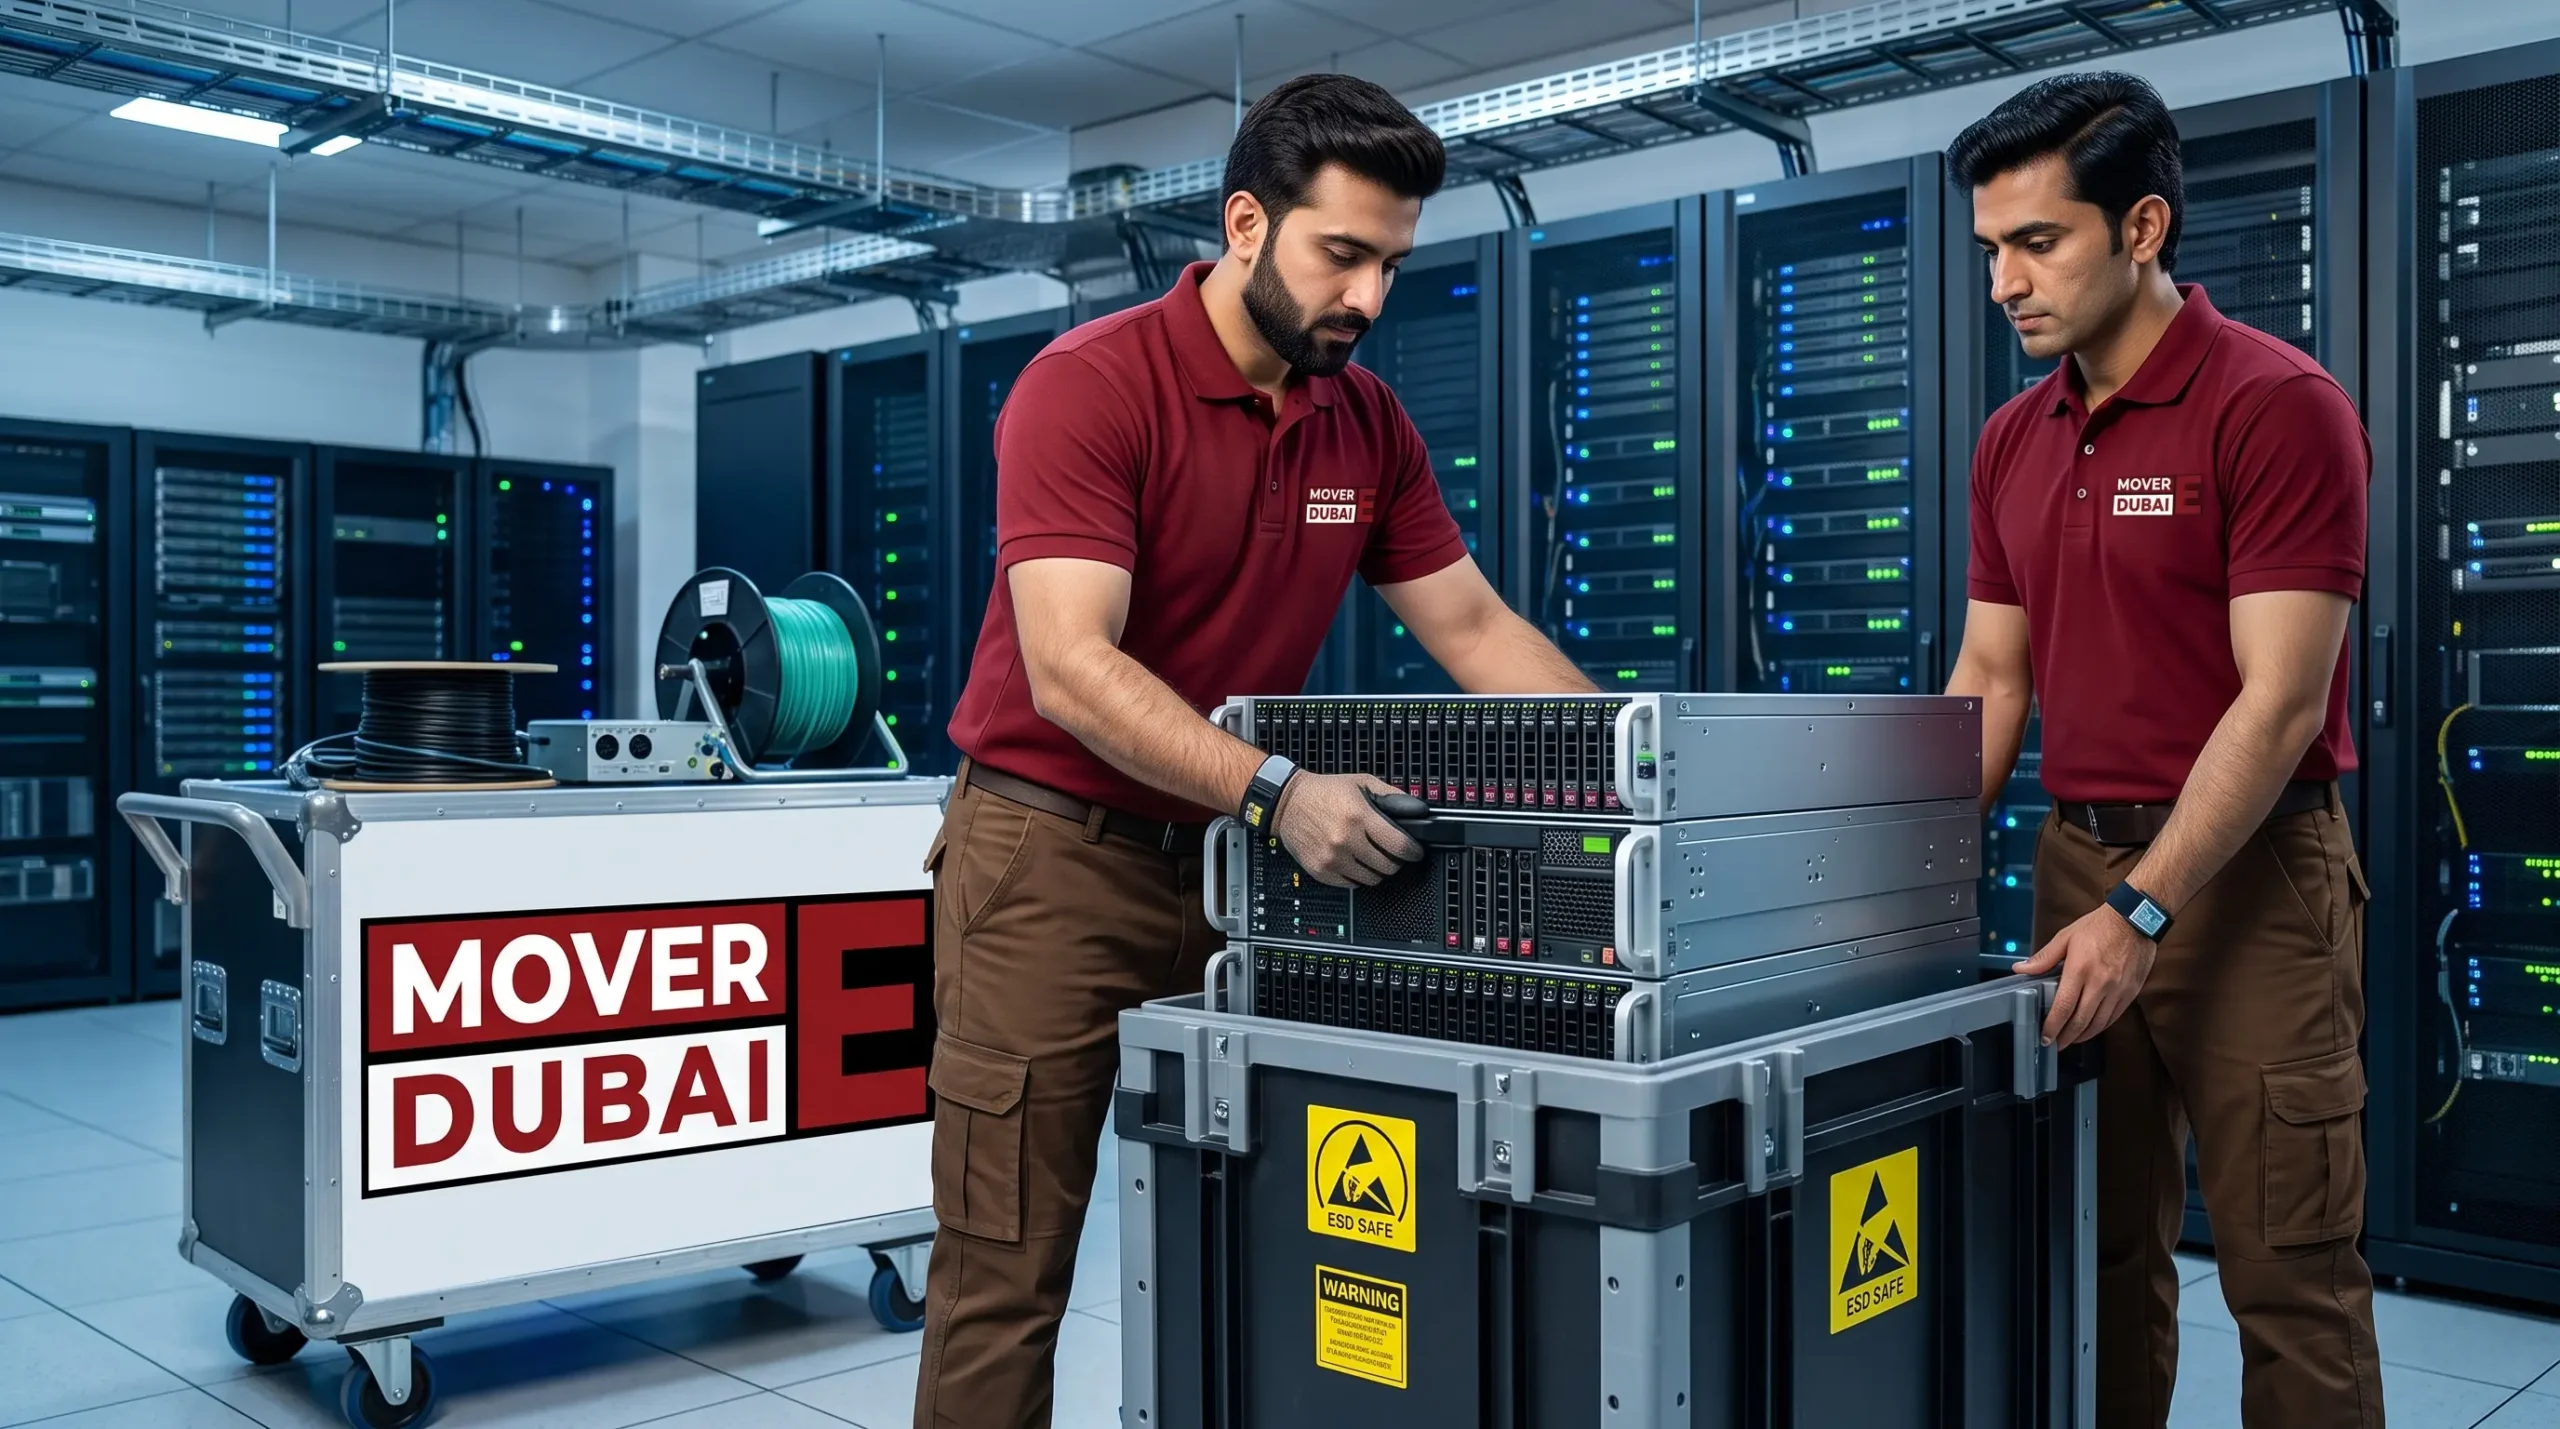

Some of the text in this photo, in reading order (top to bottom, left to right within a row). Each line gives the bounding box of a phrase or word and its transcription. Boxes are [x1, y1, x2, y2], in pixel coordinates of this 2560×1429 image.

[1309, 488, 1355, 500] MOVER
[2117, 477, 2171, 490] MOVER
[2175, 475, 2201, 515] E
[1309, 507, 1353, 520] DUBAI
[1356, 488, 1376, 522] E
[2116, 498, 2169, 512] DUBAI
[392, 922, 769, 1035] MOVER
[797, 898, 926, 1130] E
[393, 1038, 769, 1168] DUBAI
[1327, 1211, 1394, 1239] ESD SAFE
[1323, 1277, 1400, 1311] WARNING
[1846, 1275, 1904, 1317] ESD SAFE
